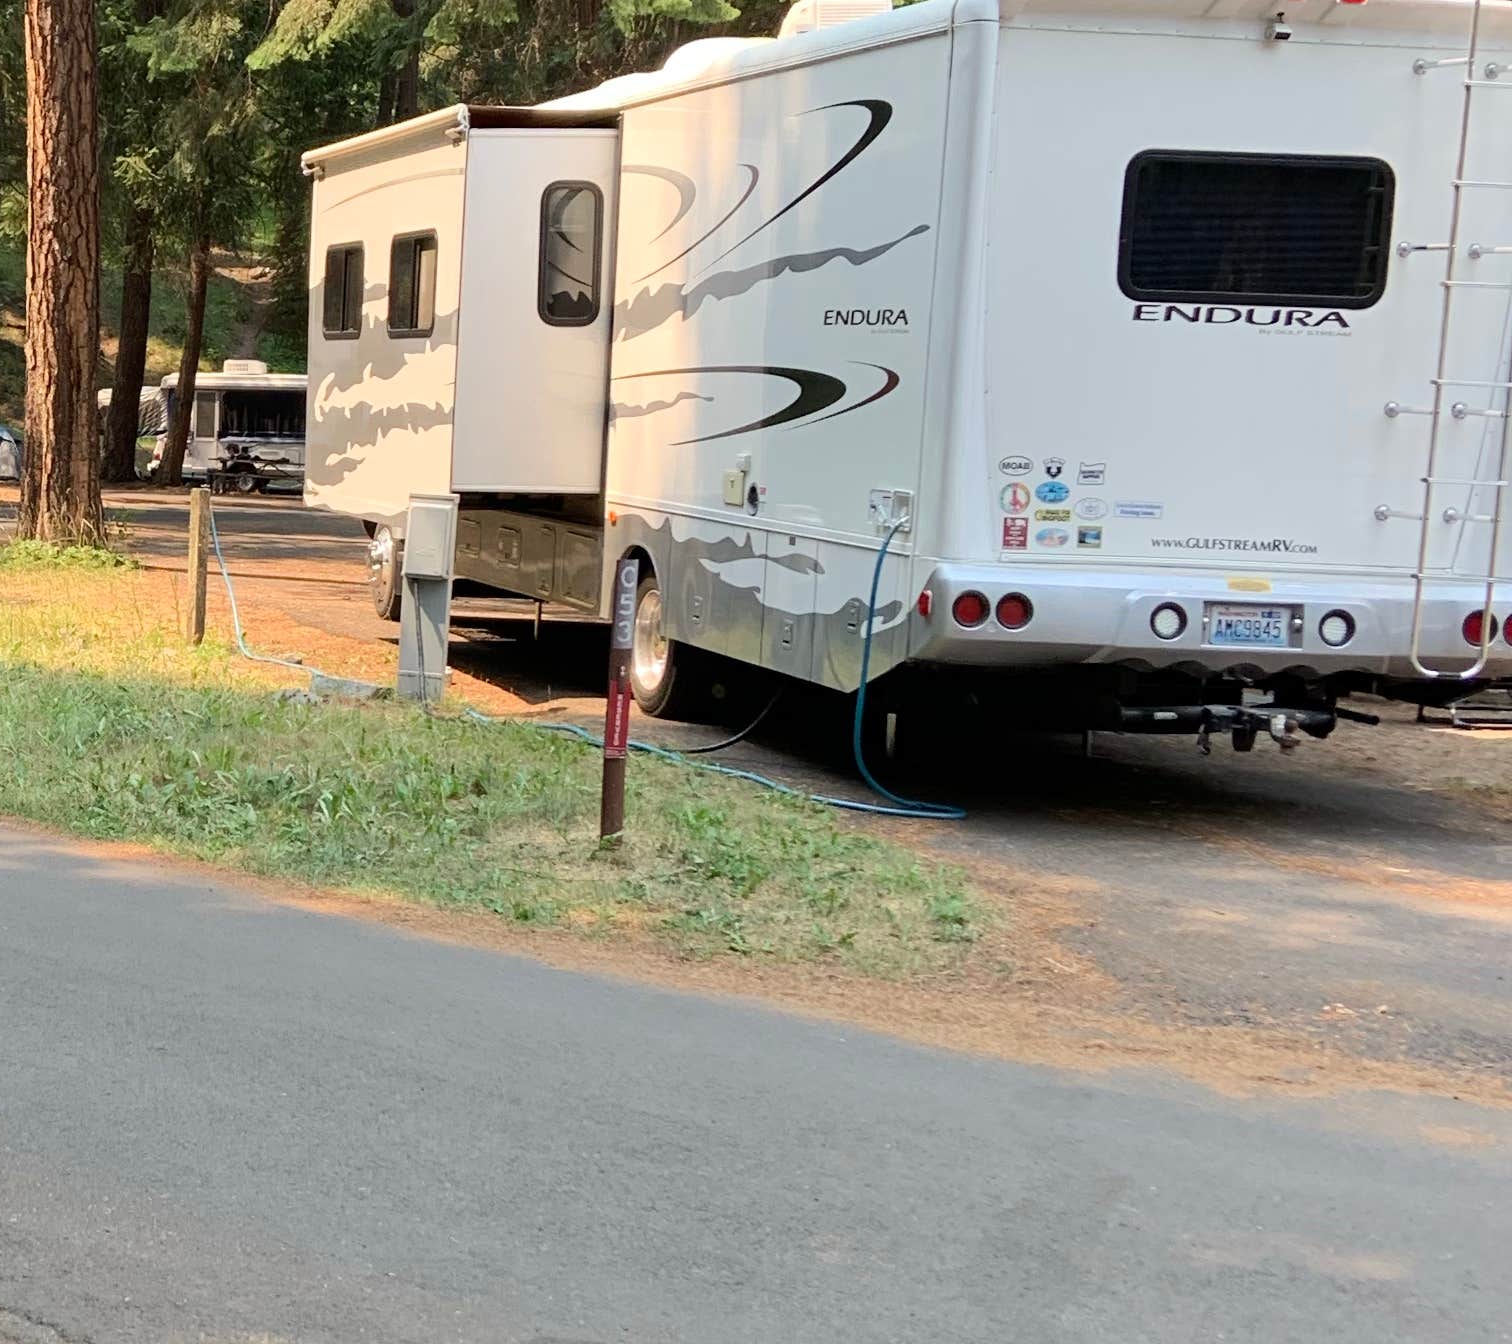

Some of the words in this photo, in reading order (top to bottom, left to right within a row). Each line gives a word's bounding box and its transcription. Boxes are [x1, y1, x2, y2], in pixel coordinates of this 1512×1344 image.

[823, 309, 908, 325] ENDURA
[1132, 304, 1350, 328] ENDURA
[1002, 462, 1030, 470] MOAB
[1152, 537, 1317, 553] WWW.GULFSTREAMRV.COM
[616, 566, 636, 642] C53
[1215, 619, 1281, 638] AMC9845
